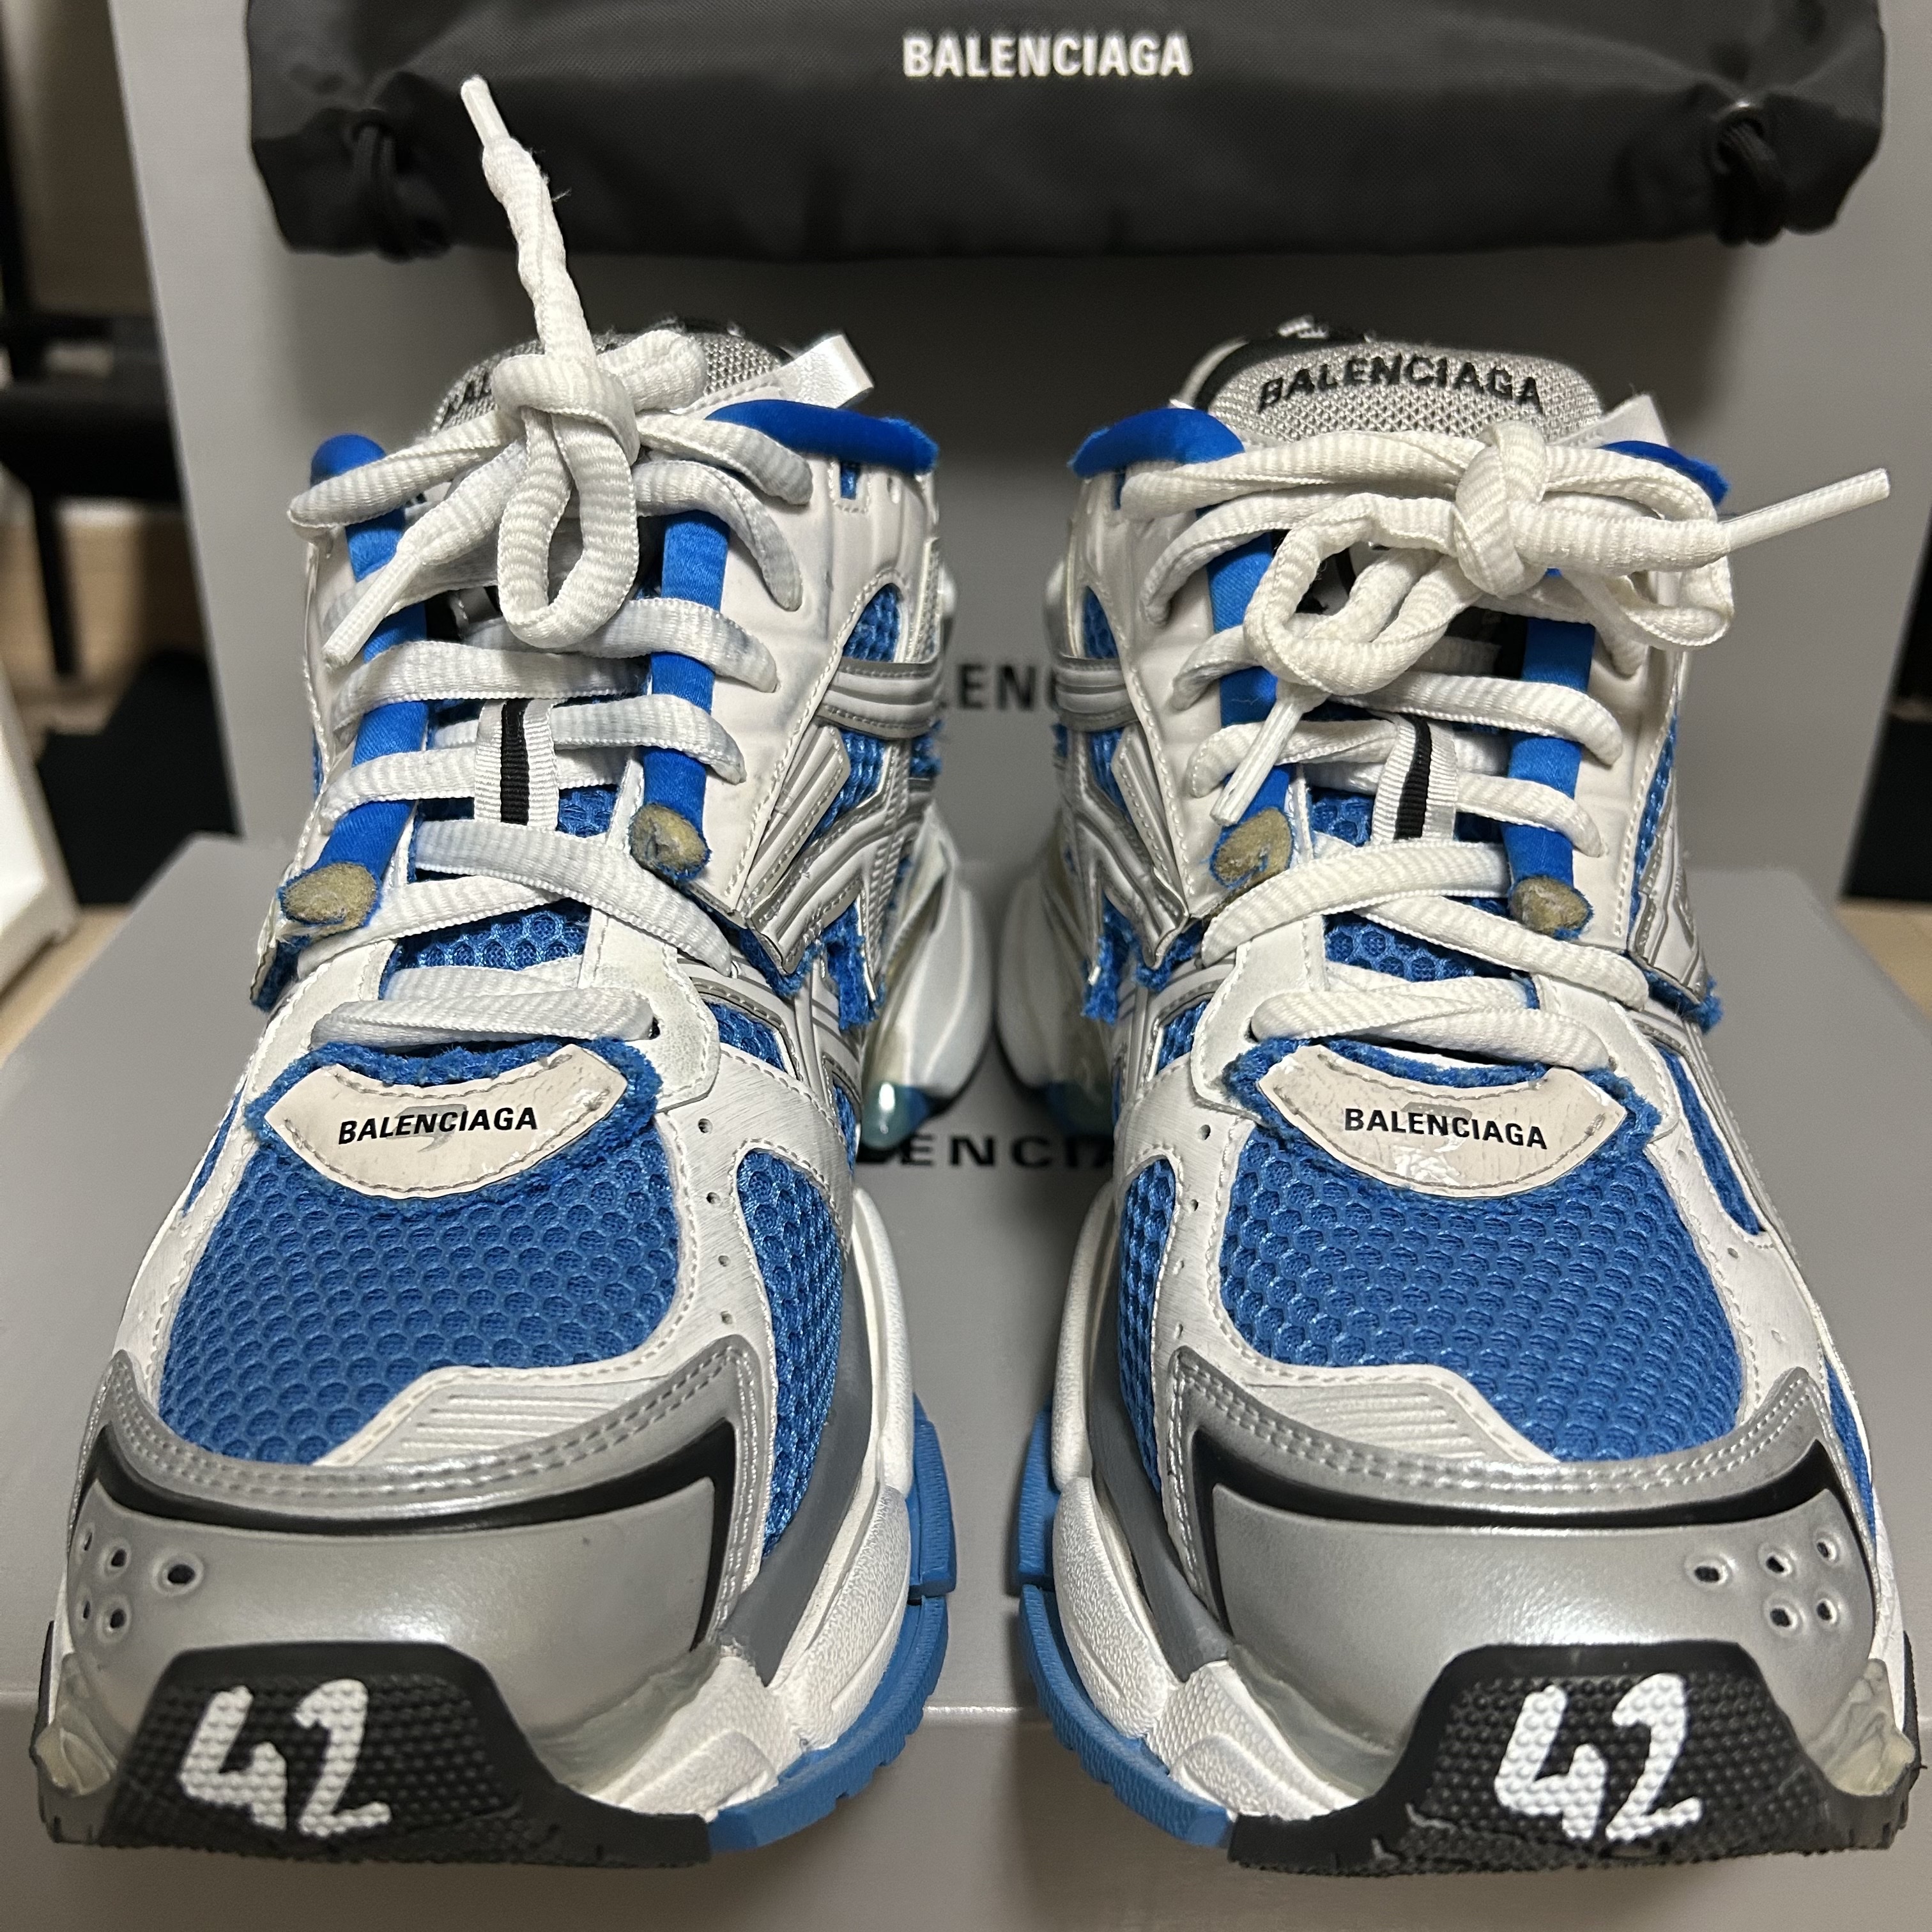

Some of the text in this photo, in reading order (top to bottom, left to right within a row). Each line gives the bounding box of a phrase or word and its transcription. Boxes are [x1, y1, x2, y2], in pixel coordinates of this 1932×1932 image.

[902, 32, 1193, 77] BALENCIAGA
[1257, 353, 1544, 415] BALENCIAGA
[338, 1107, 538, 1145] BALENCIAGA
[1344, 1107, 1548, 1150] BALENCIAGA
[179, 1678, 392, 1837] 42
[1494, 1672, 1704, 1841] 42
